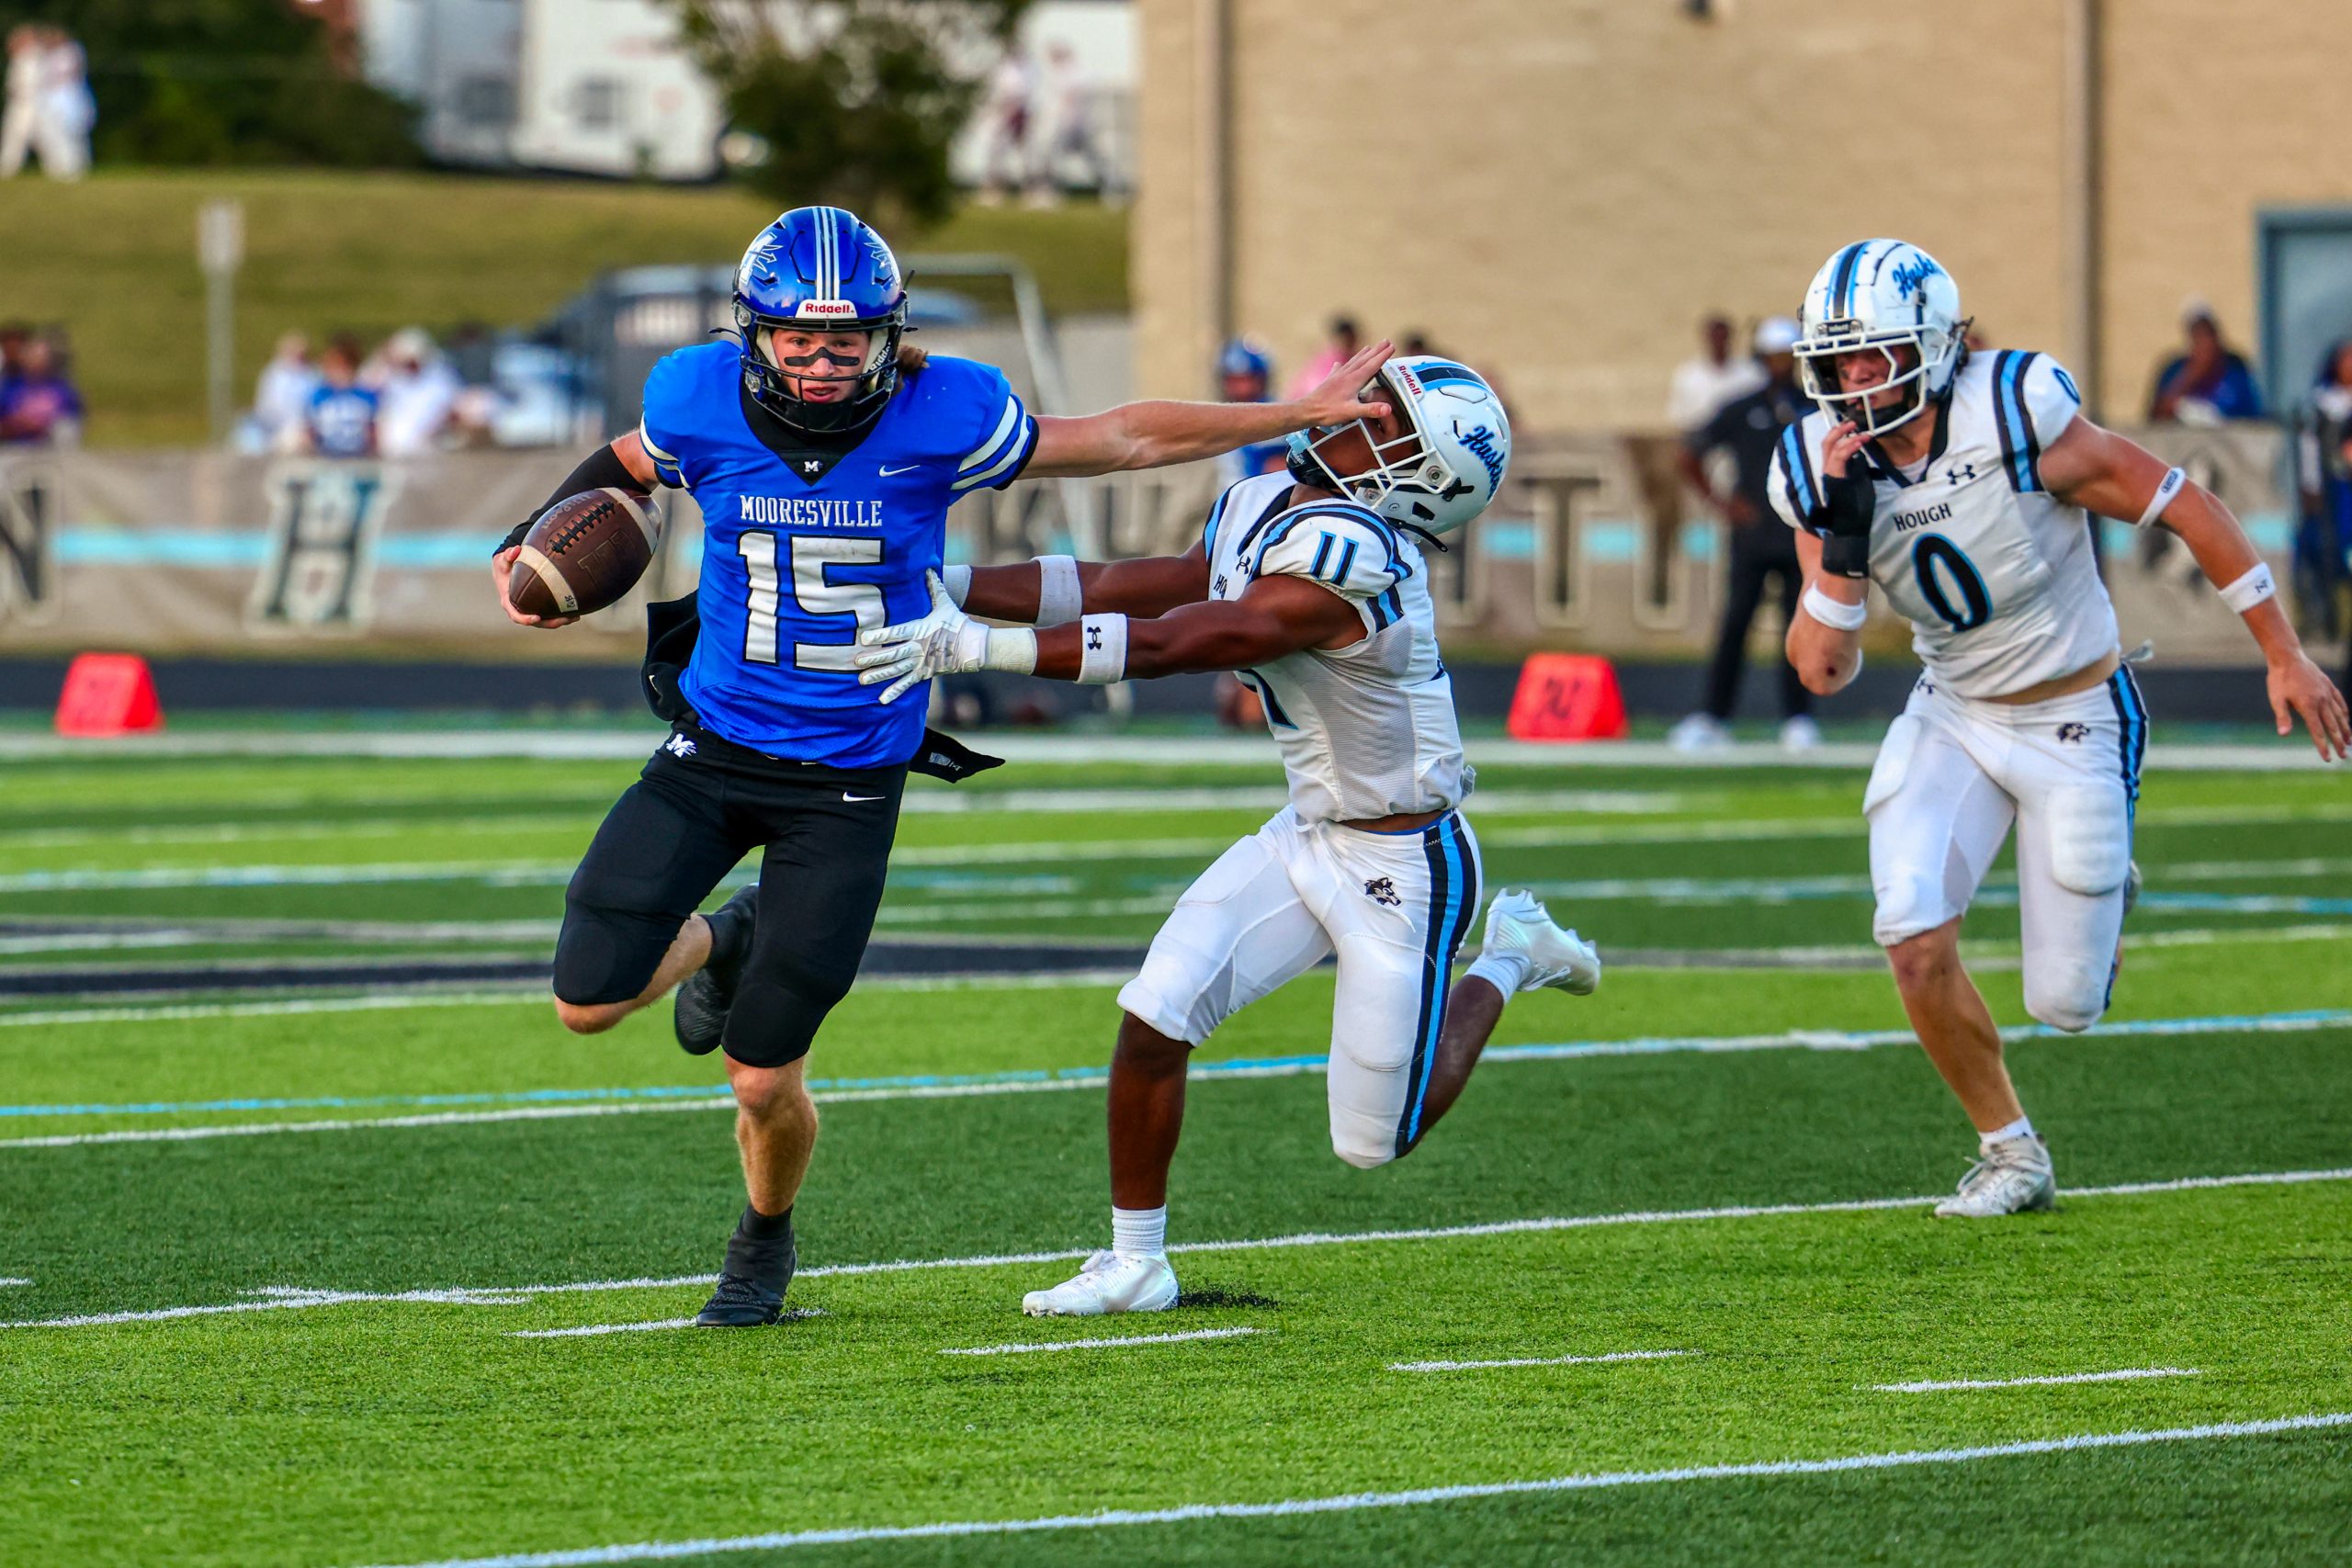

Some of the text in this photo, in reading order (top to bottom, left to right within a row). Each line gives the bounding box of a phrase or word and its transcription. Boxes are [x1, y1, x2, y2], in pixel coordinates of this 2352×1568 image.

[805, 303, 851, 313] Riddell
[1398, 365, 1422, 395] Riddell
[740, 494, 883, 528] MOORESVILLE
[1894, 502, 1952, 532] HOUGH
[1309, 530, 1360, 589] 11
[1911, 532, 1994, 632] 0
[737, 528, 888, 674] 15
